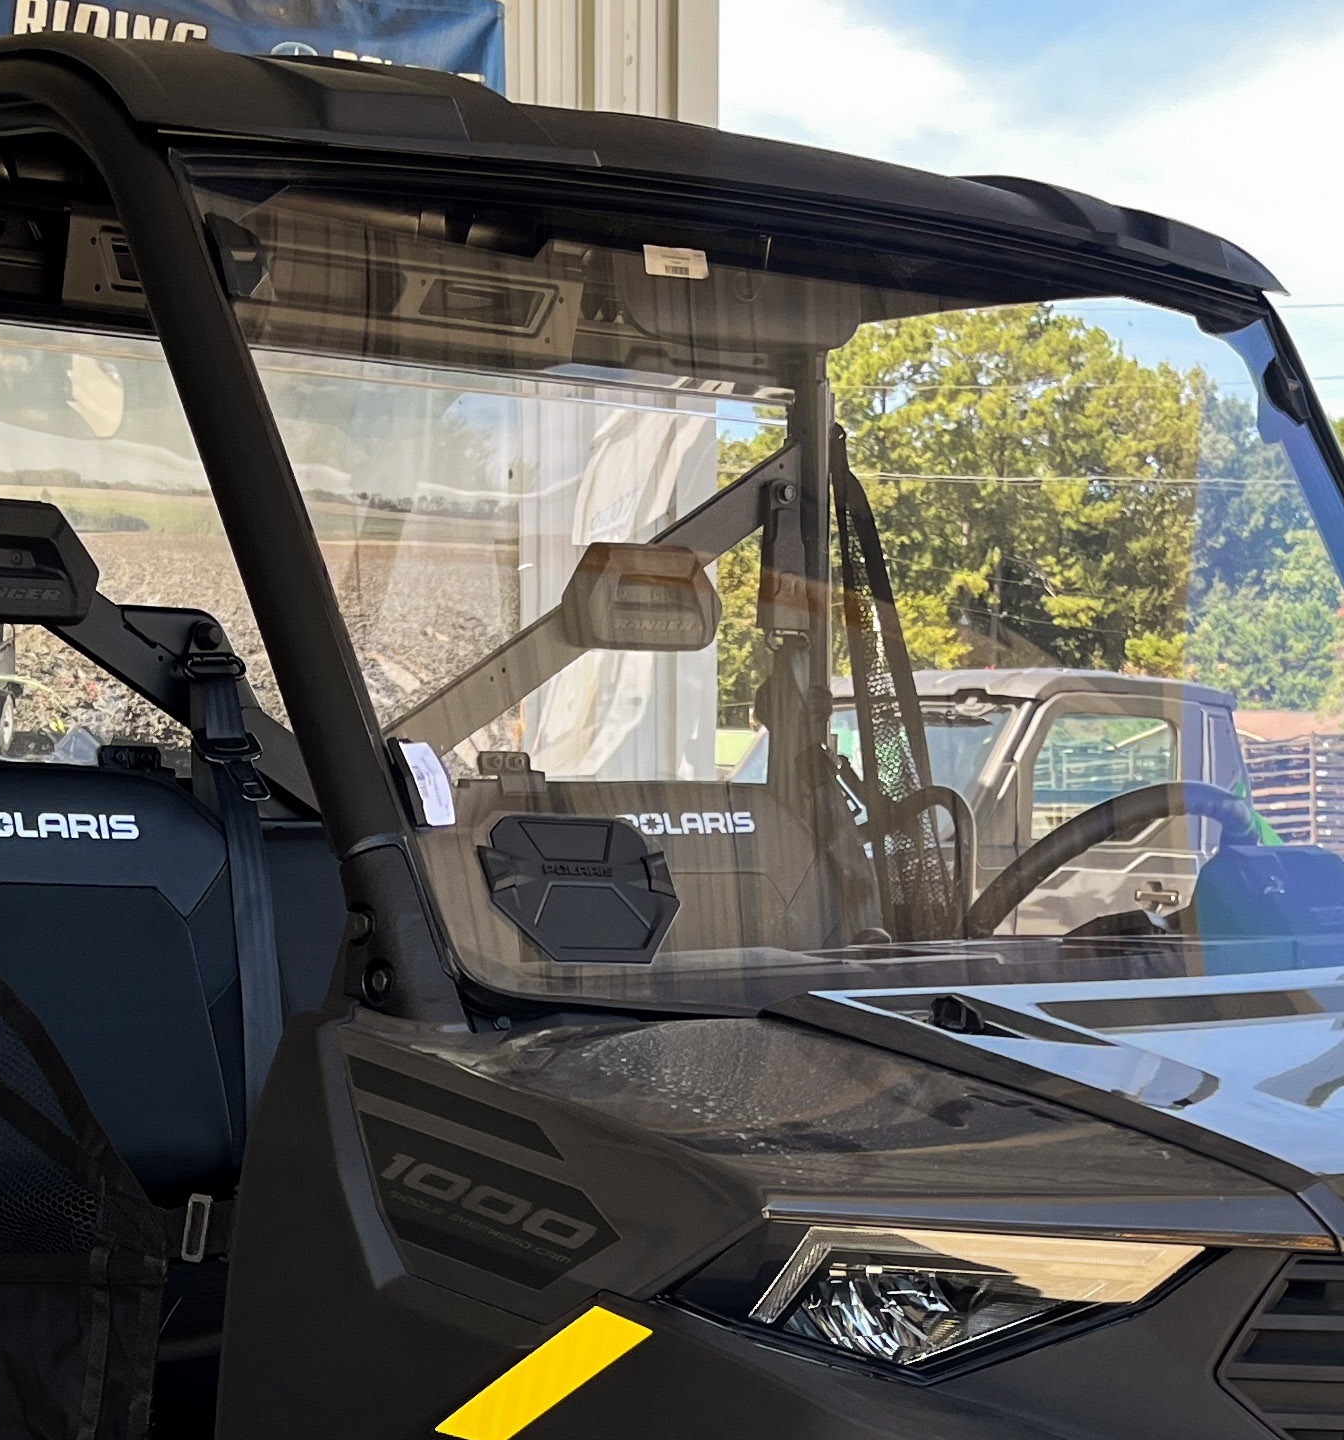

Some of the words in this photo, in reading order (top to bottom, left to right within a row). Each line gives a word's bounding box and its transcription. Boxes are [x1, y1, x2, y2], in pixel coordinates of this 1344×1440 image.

[13, 0, 207, 43] RIDING
[541, 864, 614, 878] POLARIS
[381, 1153, 597, 1250] 1000
